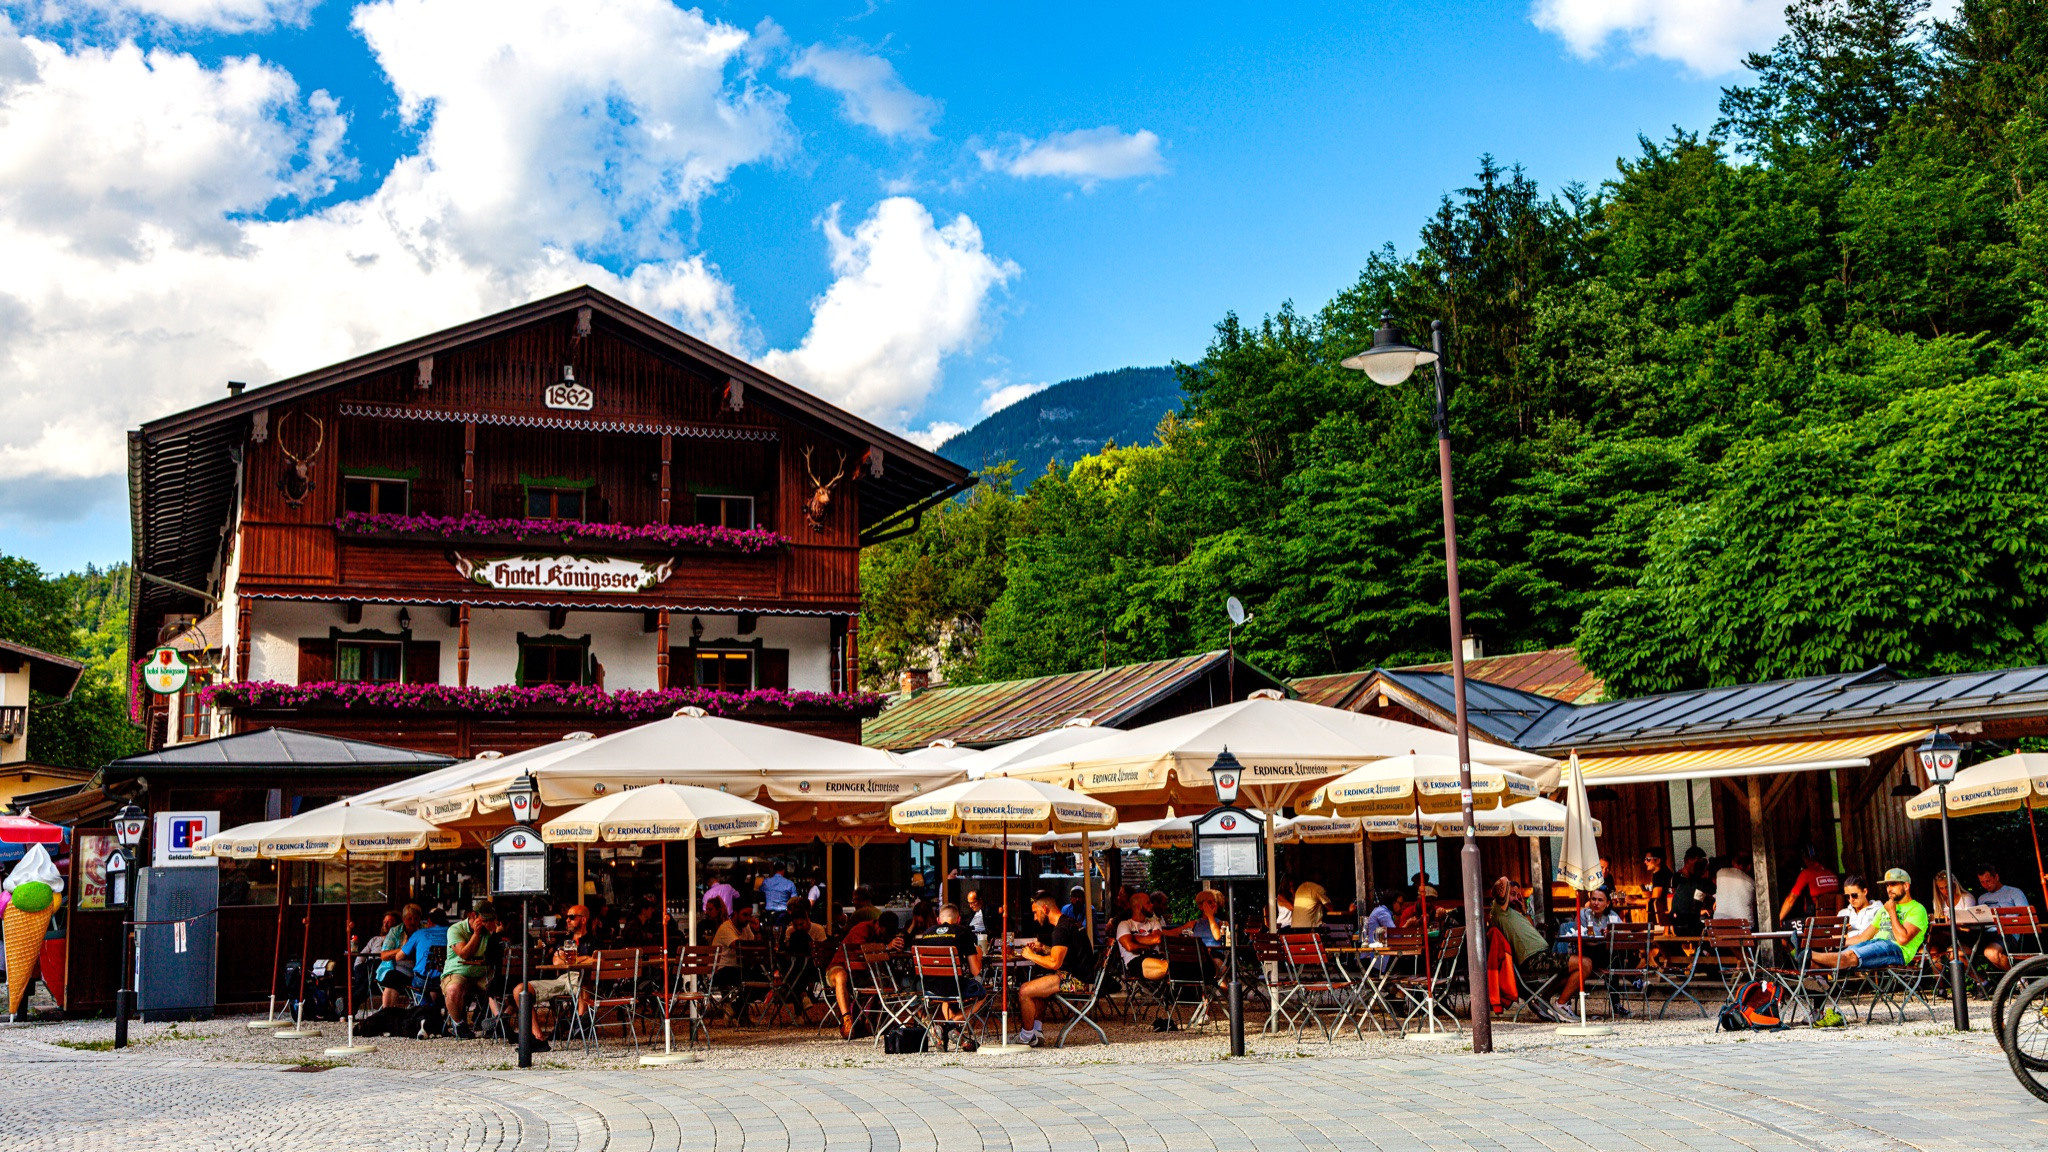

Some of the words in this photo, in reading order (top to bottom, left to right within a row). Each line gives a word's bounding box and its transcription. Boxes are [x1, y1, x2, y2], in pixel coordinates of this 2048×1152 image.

[548, 386, 590, 407] 1862
[495, 563, 540, 588] Hotel
[543, 565, 639, 591] Königssee
[1253, 765, 1295, 775] ERDINGER
[1092, 773, 1117, 783] ERDINGER
[826, 781, 866, 792] ERDINGER
[1344, 788, 1374, 796] ERDINGER
[1961, 790, 1992, 802] ERDINGER
[906, 809, 929, 818] ERDINGER
[973, 806, 1005, 814] ERDINGER
[617, 827, 651, 835] ERDINGER
[709, 822, 736, 831] ERDINGER
[1523, 824, 1548, 832] ERDINGER
[556, 828, 578, 836] ERDINGER
[276, 842, 305, 850] ERDINGER
[357, 838, 385, 846] ERDINGER
